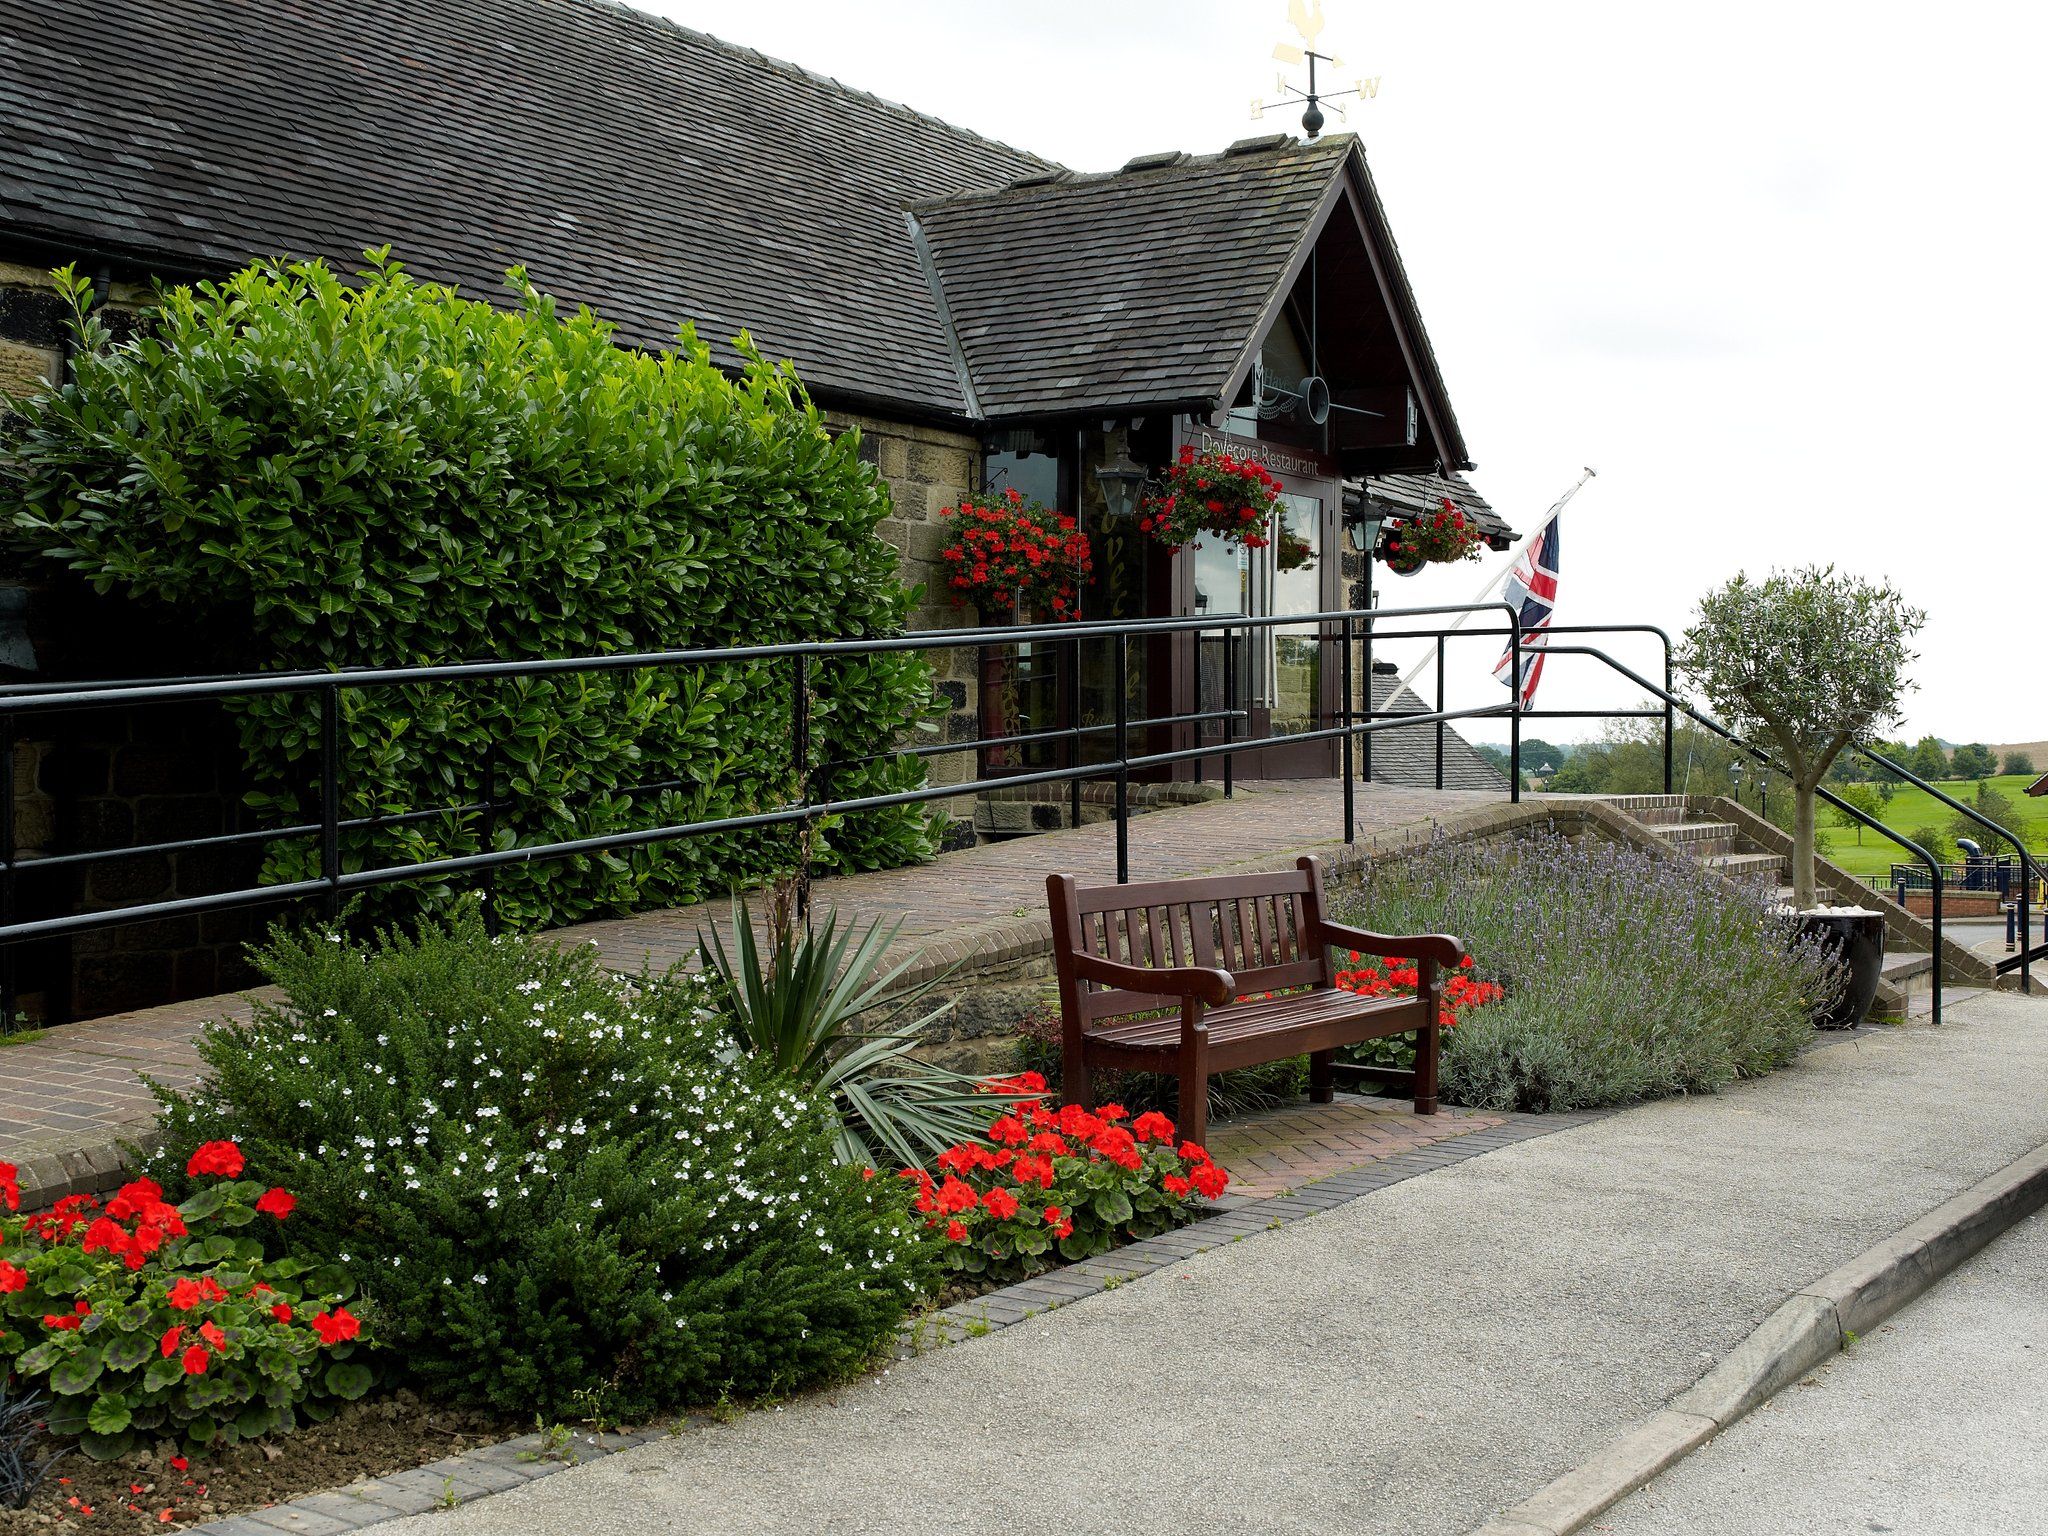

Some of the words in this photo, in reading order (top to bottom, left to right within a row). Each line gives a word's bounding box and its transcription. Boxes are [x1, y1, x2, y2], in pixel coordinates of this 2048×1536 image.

[1354, 75, 1382, 100] W
[1201, 431, 1259, 463] Dovecote
[1261, 444, 1320, 476] Restaurant
